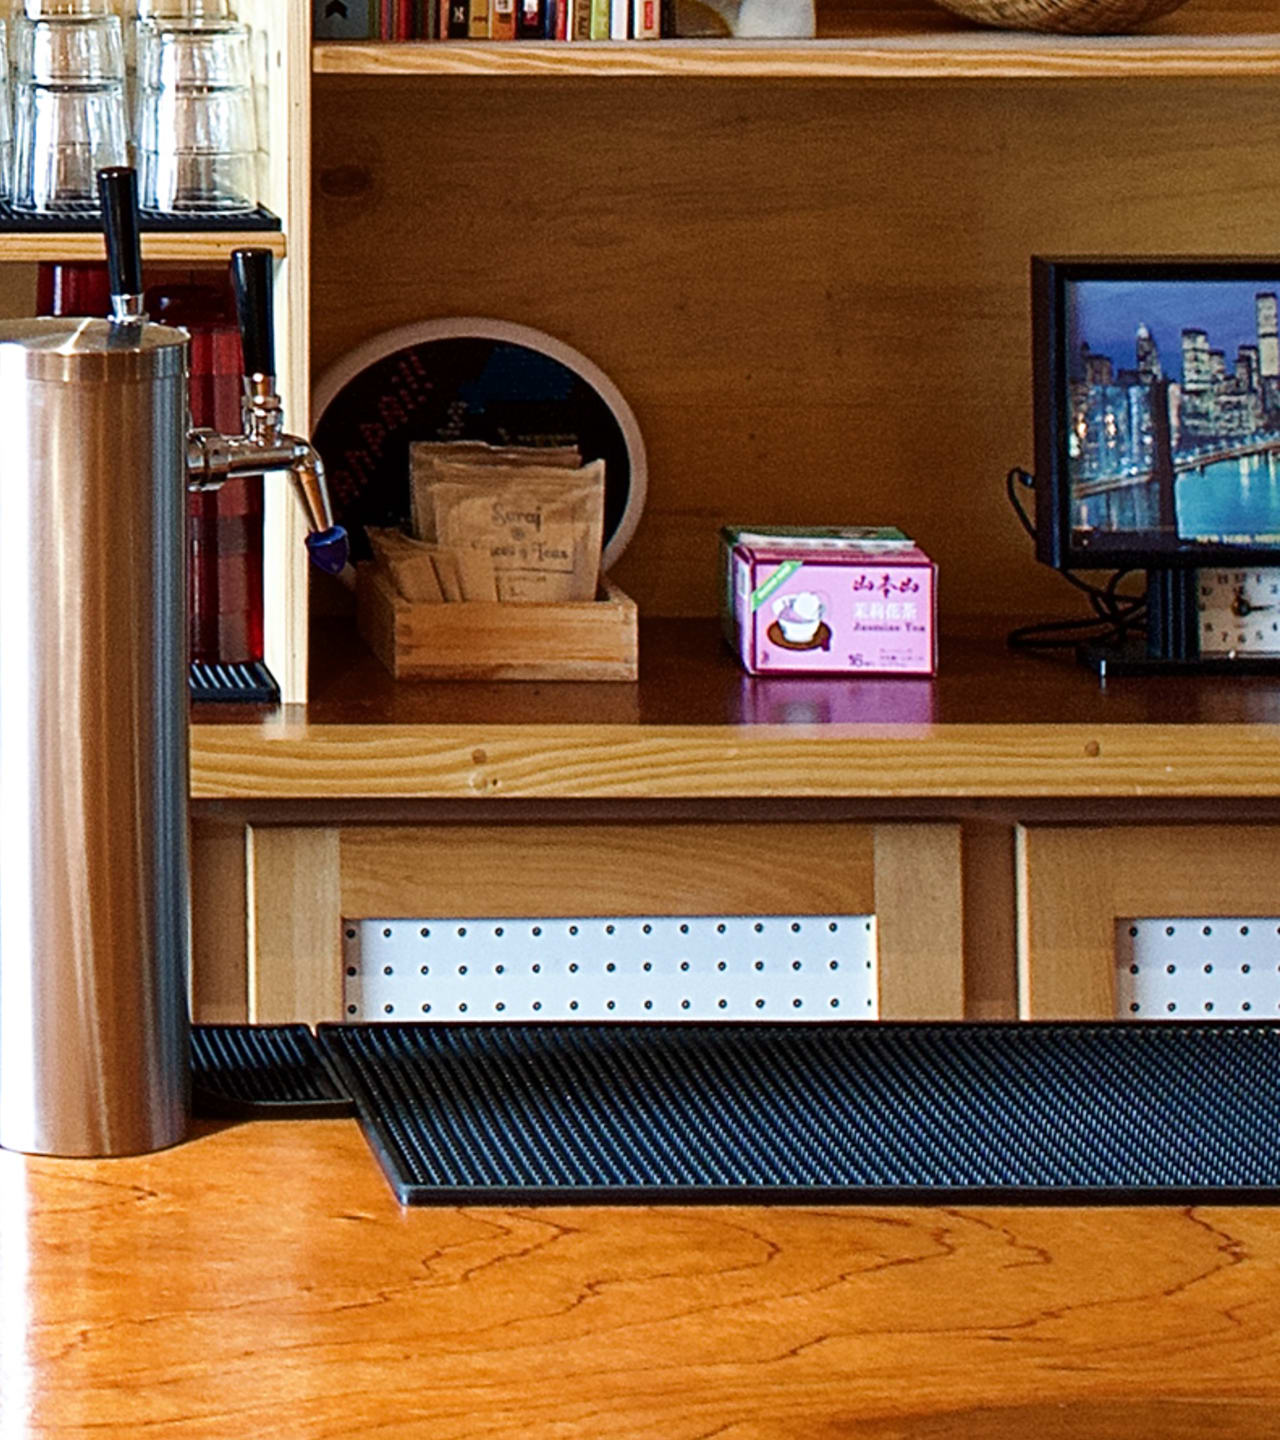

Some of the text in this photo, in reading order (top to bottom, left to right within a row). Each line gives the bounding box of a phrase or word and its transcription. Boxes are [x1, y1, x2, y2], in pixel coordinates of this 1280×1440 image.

[533, 540, 569, 562] Teas
[852, 573, 921, 599] 山本山
[904, 622, 927, 633] Tea
